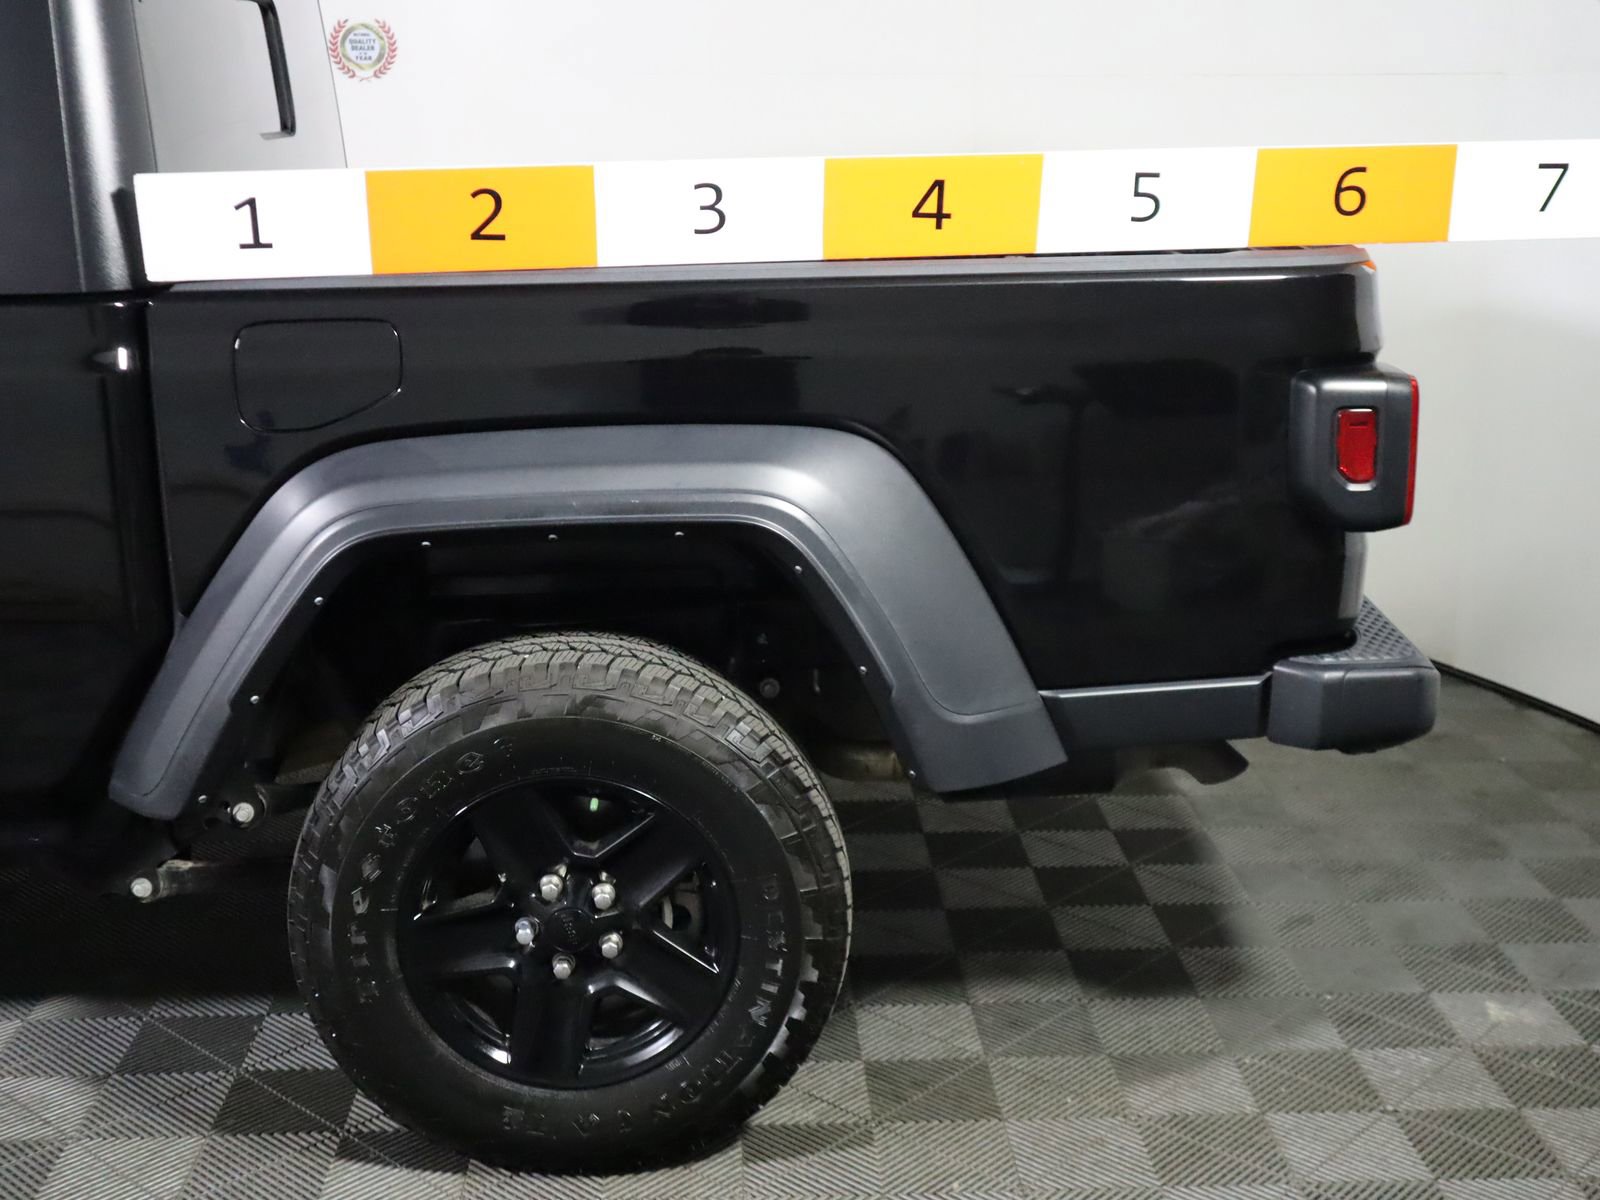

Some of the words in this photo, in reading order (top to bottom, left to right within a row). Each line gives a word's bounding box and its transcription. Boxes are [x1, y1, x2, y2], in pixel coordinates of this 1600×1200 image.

[235, 198, 273, 249] 1
[470, 189, 506, 241] 2
[694, 184, 726, 234] 3
[911, 180, 952, 230] 4
[1131, 173, 1160, 222] 5
[1335, 167, 1367, 216] 6
[1538, 164, 1569, 212] 7
